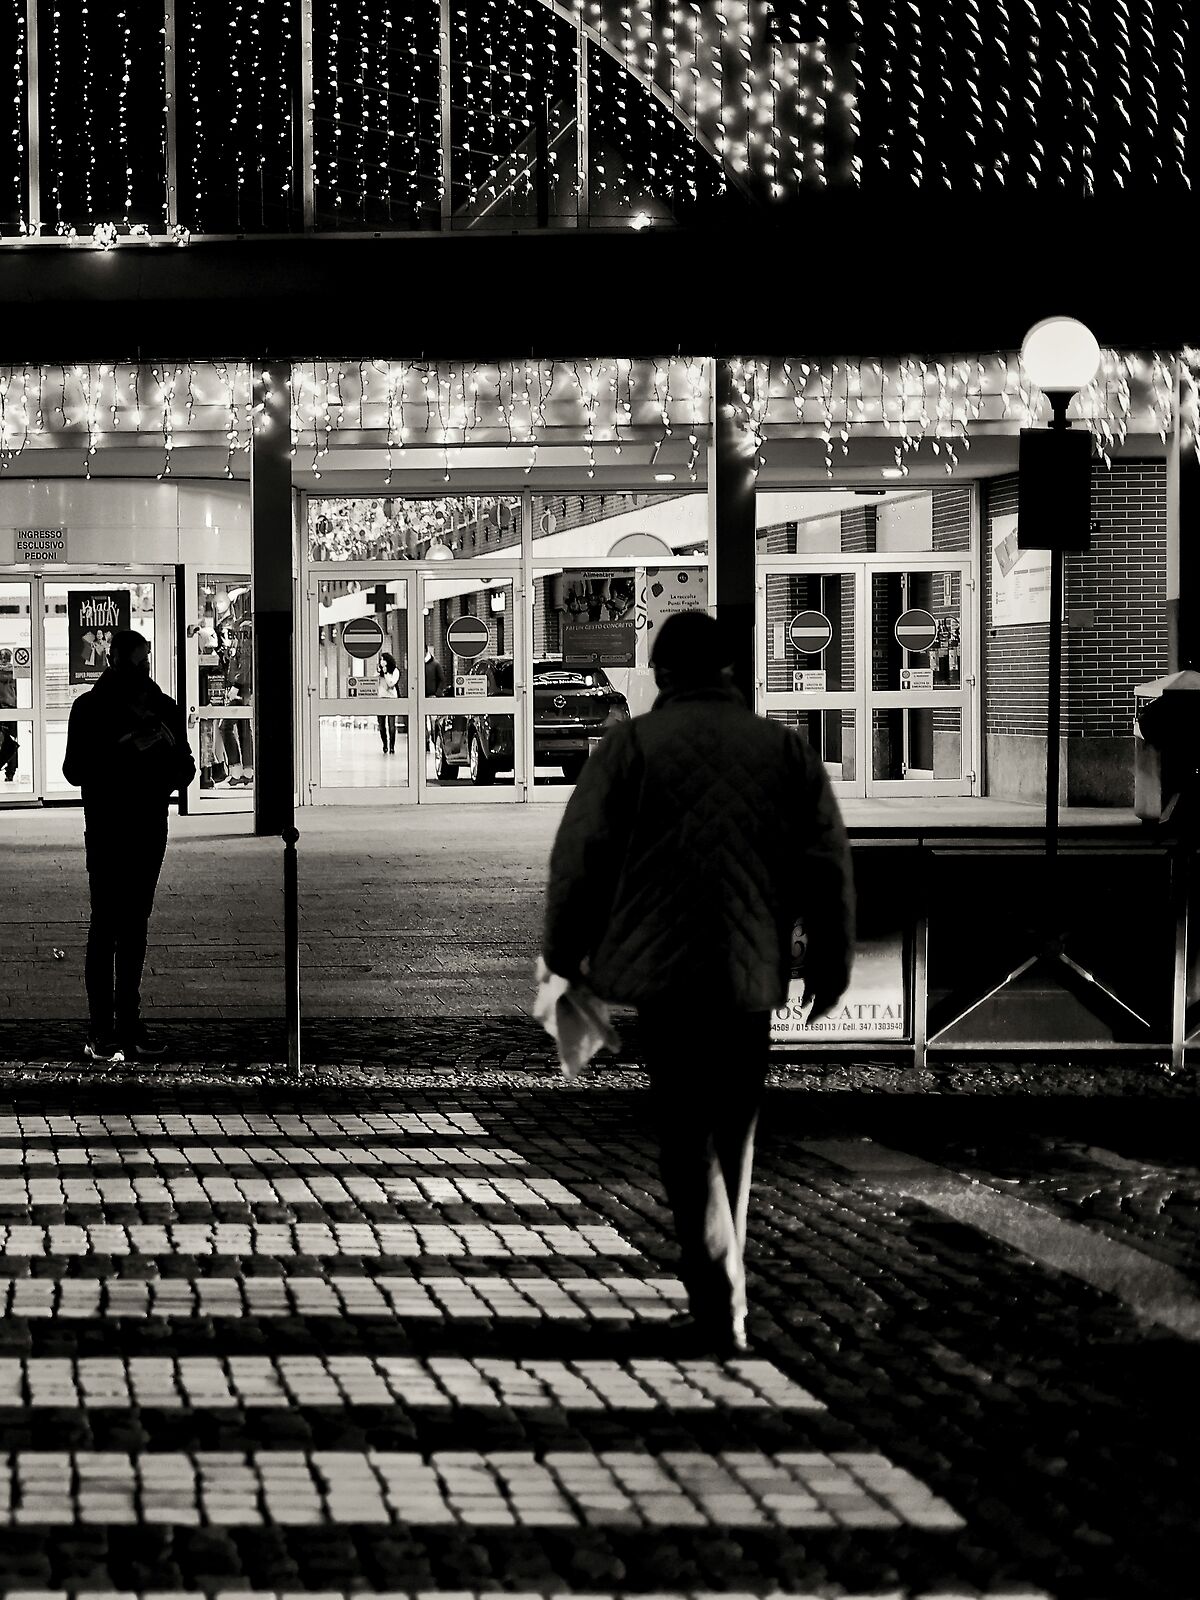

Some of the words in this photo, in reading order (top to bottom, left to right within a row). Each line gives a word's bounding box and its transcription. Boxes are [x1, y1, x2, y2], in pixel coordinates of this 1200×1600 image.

[18, 530, 62, 539] INGRESSO
[17, 541, 64, 550] ESCLUSIVO
[24, 552, 57, 560] PEDONI
[81, 596, 118, 614] Black
[79, 608, 120, 627] FRIDAY
[227, 631, 251, 640] ENTR
